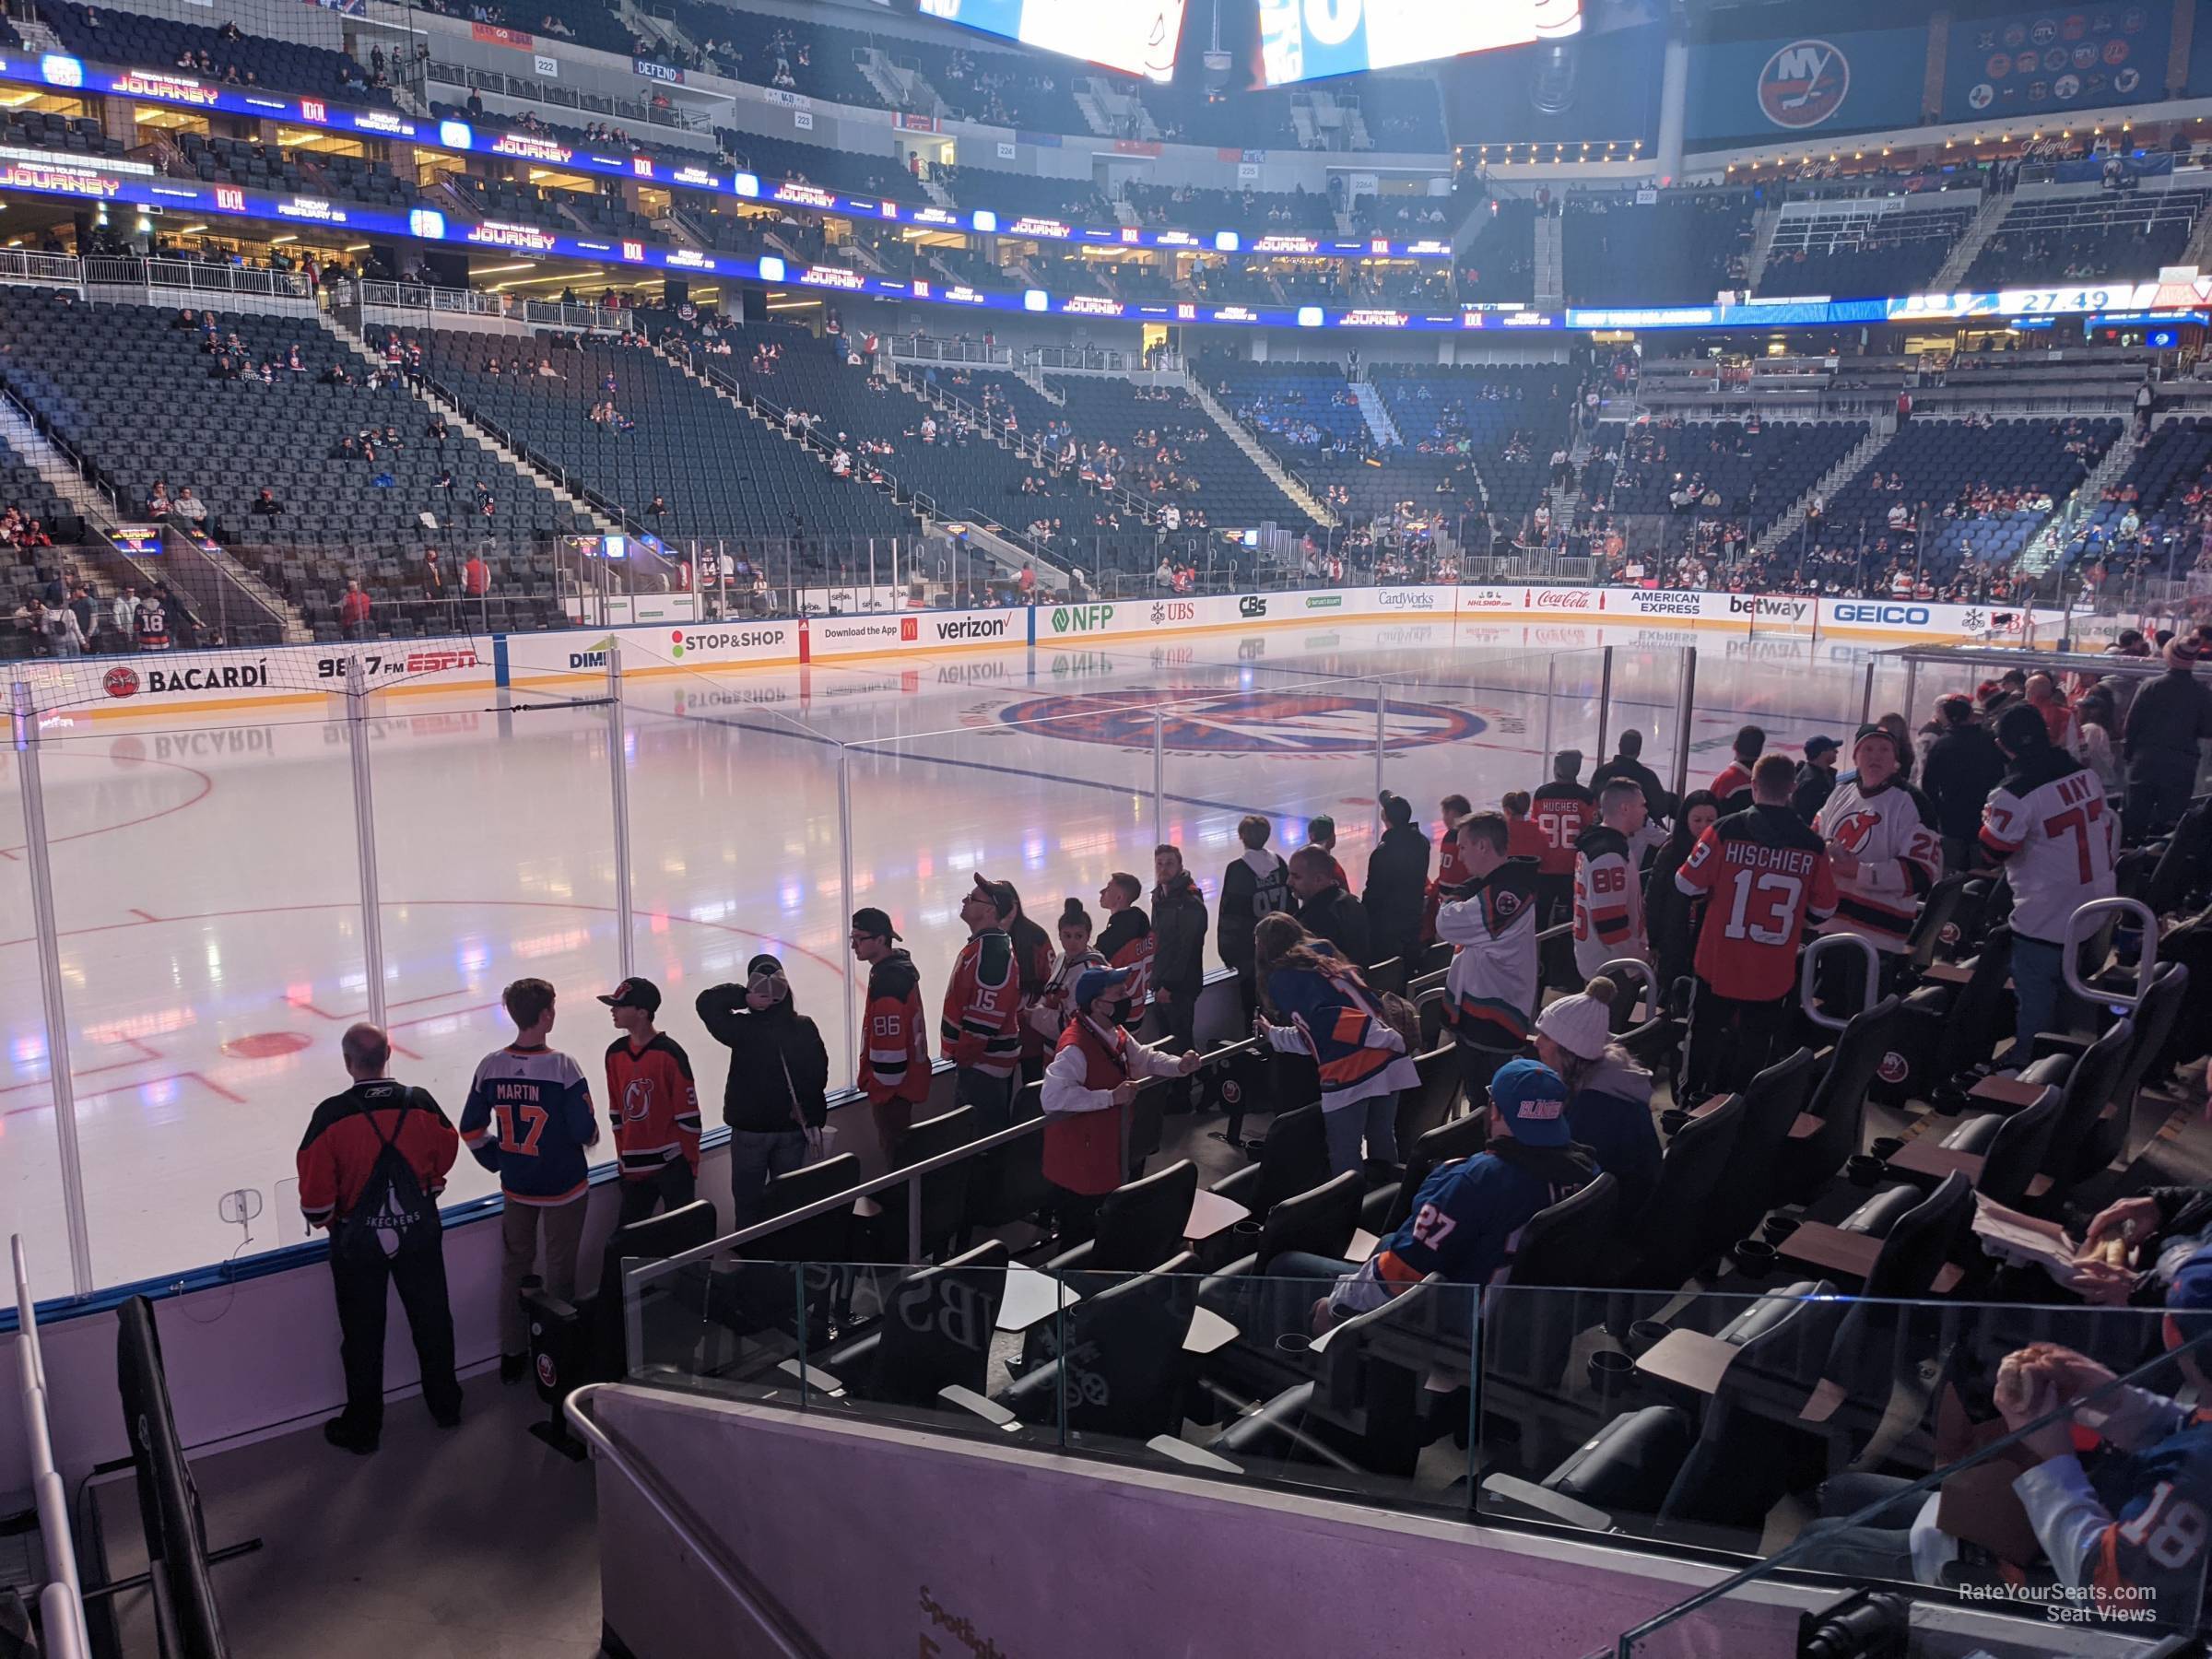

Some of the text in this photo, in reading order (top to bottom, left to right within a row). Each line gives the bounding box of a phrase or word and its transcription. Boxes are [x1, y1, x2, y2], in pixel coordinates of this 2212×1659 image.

[538, 61, 554, 72] 222
[638, 62, 677, 82] DEFEND
[112, 76, 218, 105] JOURNEY
[301, 100, 327, 123] IDOL
[370, 112, 400, 124] FRIDAY
[797, 116, 810, 126] 223
[492, 139, 572, 163] JOURNEY
[0, 170, 120, 196] JOURNEY
[216, 188, 246, 211] IDOL
[294, 198, 329, 211] FRIDAY
[774, 188, 836, 207] JOURNEY
[467, 227, 556, 250] JOURNEY
[1010, 221, 1071, 238] JOURNEY
[1253, 241, 1318, 253] JOURNEY
[801, 271, 865, 288] JOURNEY
[1063, 300, 1124, 315] JOURNEY
[1379, 589, 1434, 609] CardWorks
[1631, 592, 1700, 604] AMERICAN
[1641, 603, 1700, 615] EXPRESS
[1729, 595, 1806, 622] betway
[1072, 604, 1114, 631] NFP
[1168, 602, 1194, 621] UBS
[1834, 604, 1930, 626] GEICO
[142, 616, 163, 634] 18
[825, 625, 898, 638] Download the App
[937, 616, 1005, 640] verizon
[685, 630, 784, 652] STOP&SHOP
[384, 663, 405, 674] FM
[406, 651, 476, 674] ESPN
[570, 652, 606, 669] DIM
[148, 657, 267, 692] BACARDÍ
[1543, 801, 1579, 812] HUGHES
[1724, 842, 1814, 876] HISCHIER
[1592, 866, 1626, 894] 86
[1724, 869, 1803, 946] 13
[975, 988, 998, 1011] 15
[873, 1015, 900, 1037] 86
[497, 1084, 540, 1102] MARTIN
[494, 1104, 549, 1157] 17
[1412, 1204, 1458, 1252] 27
[2119, 1480, 2209, 1569] 18
